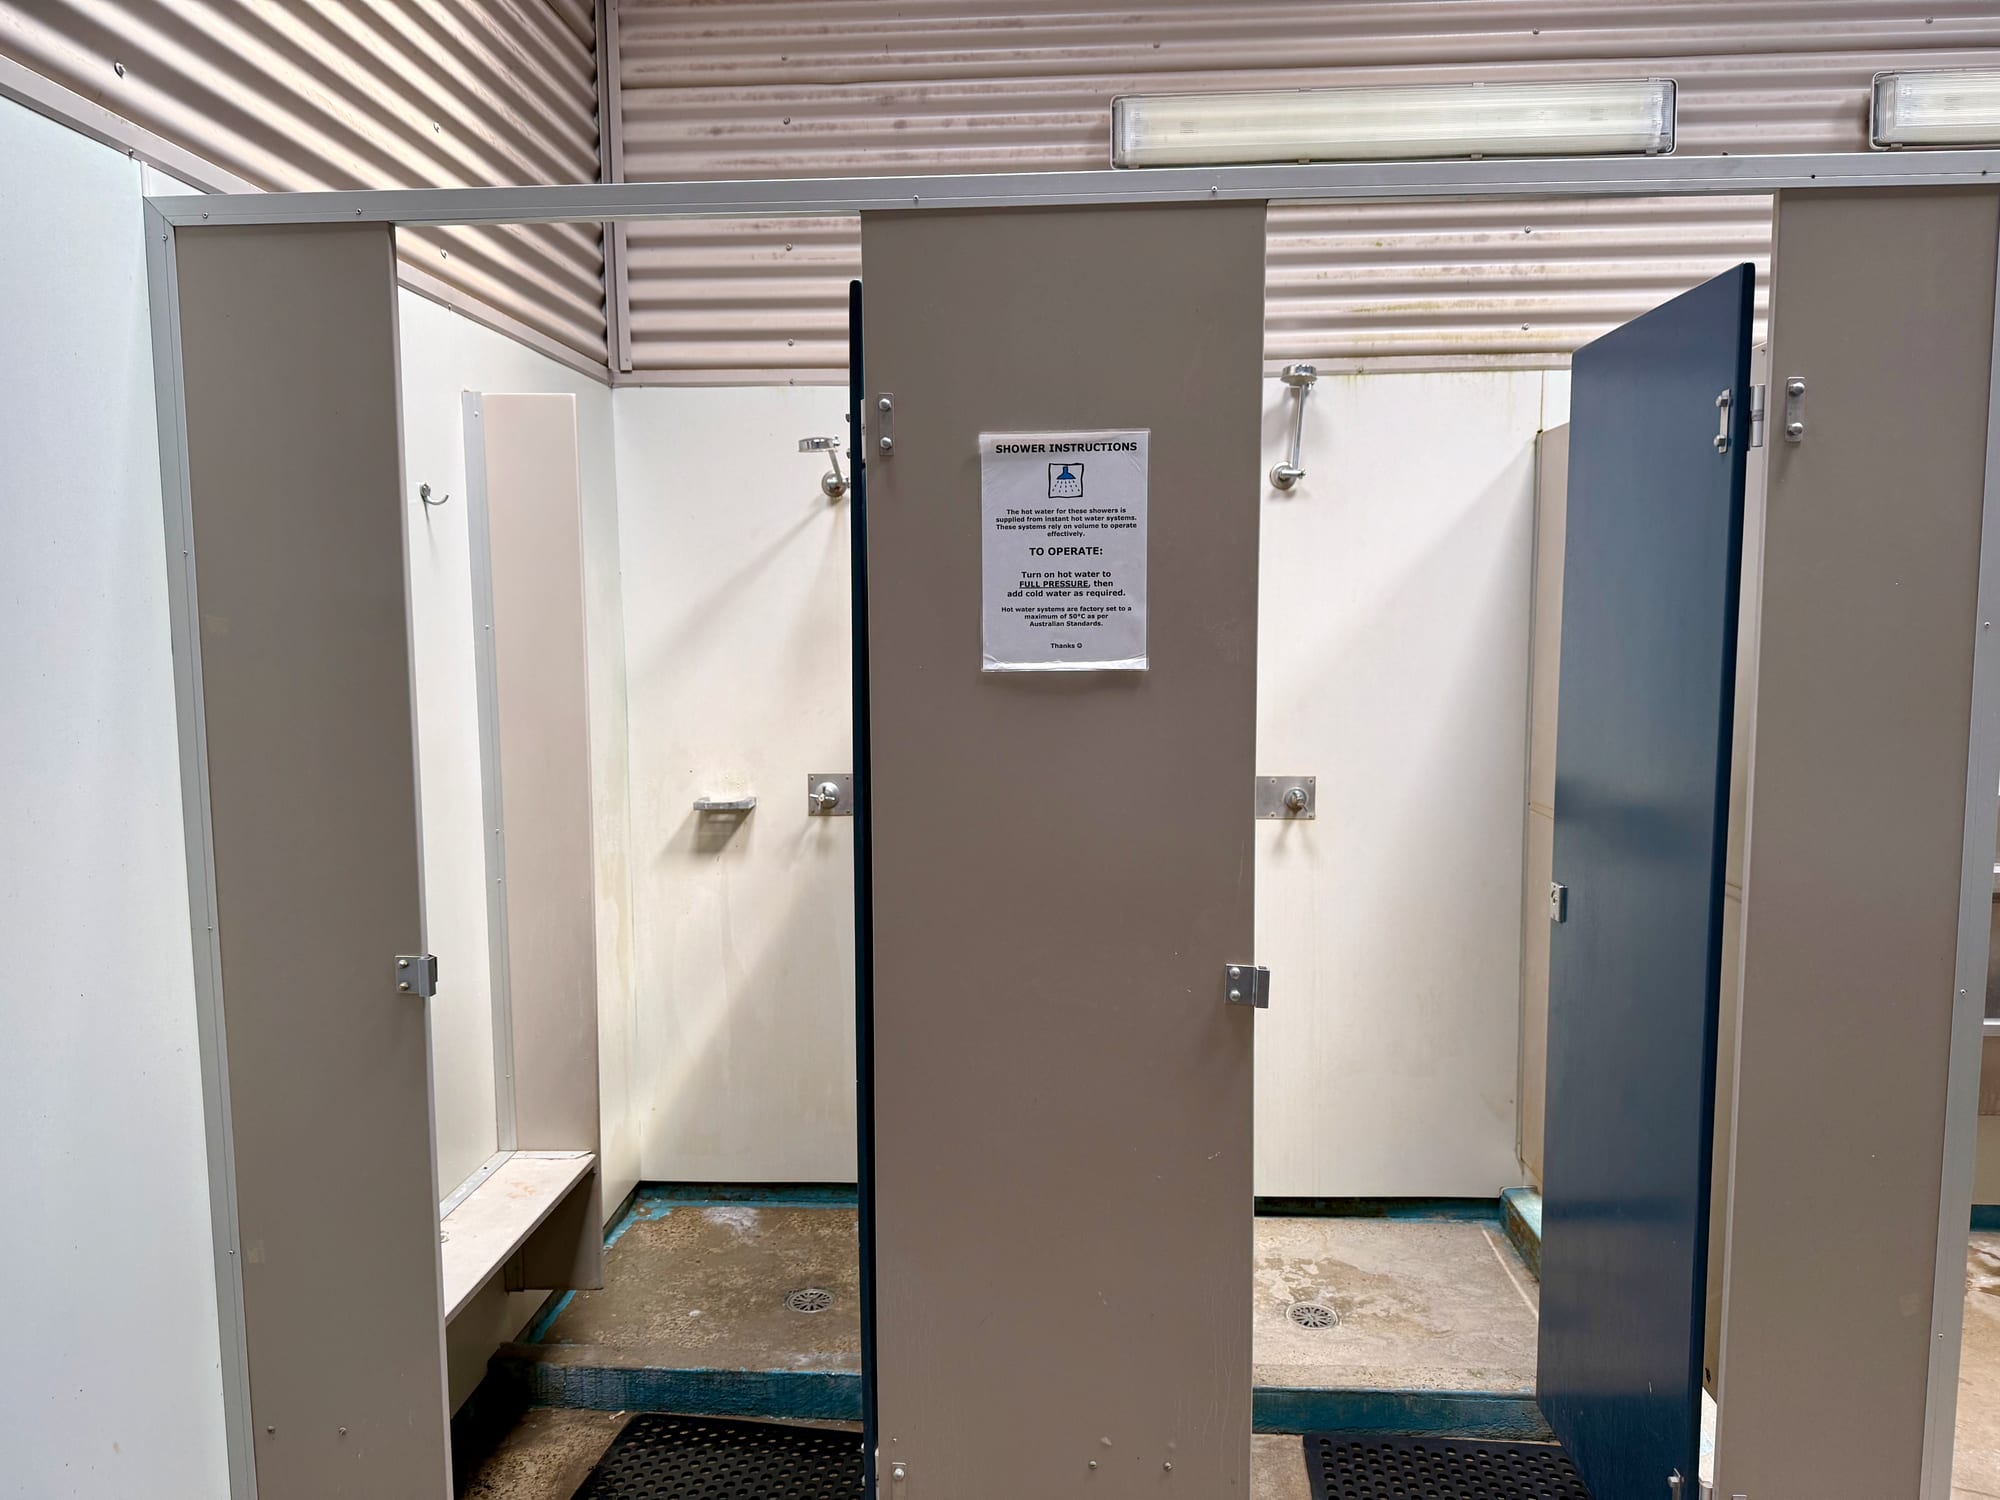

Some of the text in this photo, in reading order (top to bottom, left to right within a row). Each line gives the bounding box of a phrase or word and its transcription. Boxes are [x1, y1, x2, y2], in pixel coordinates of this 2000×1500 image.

[996, 442, 1137, 453] SHOWER INSTRUCTIONS
[1029, 547, 1103, 556] TO OPERATE:
[1086, 590, 1125, 598] required.
